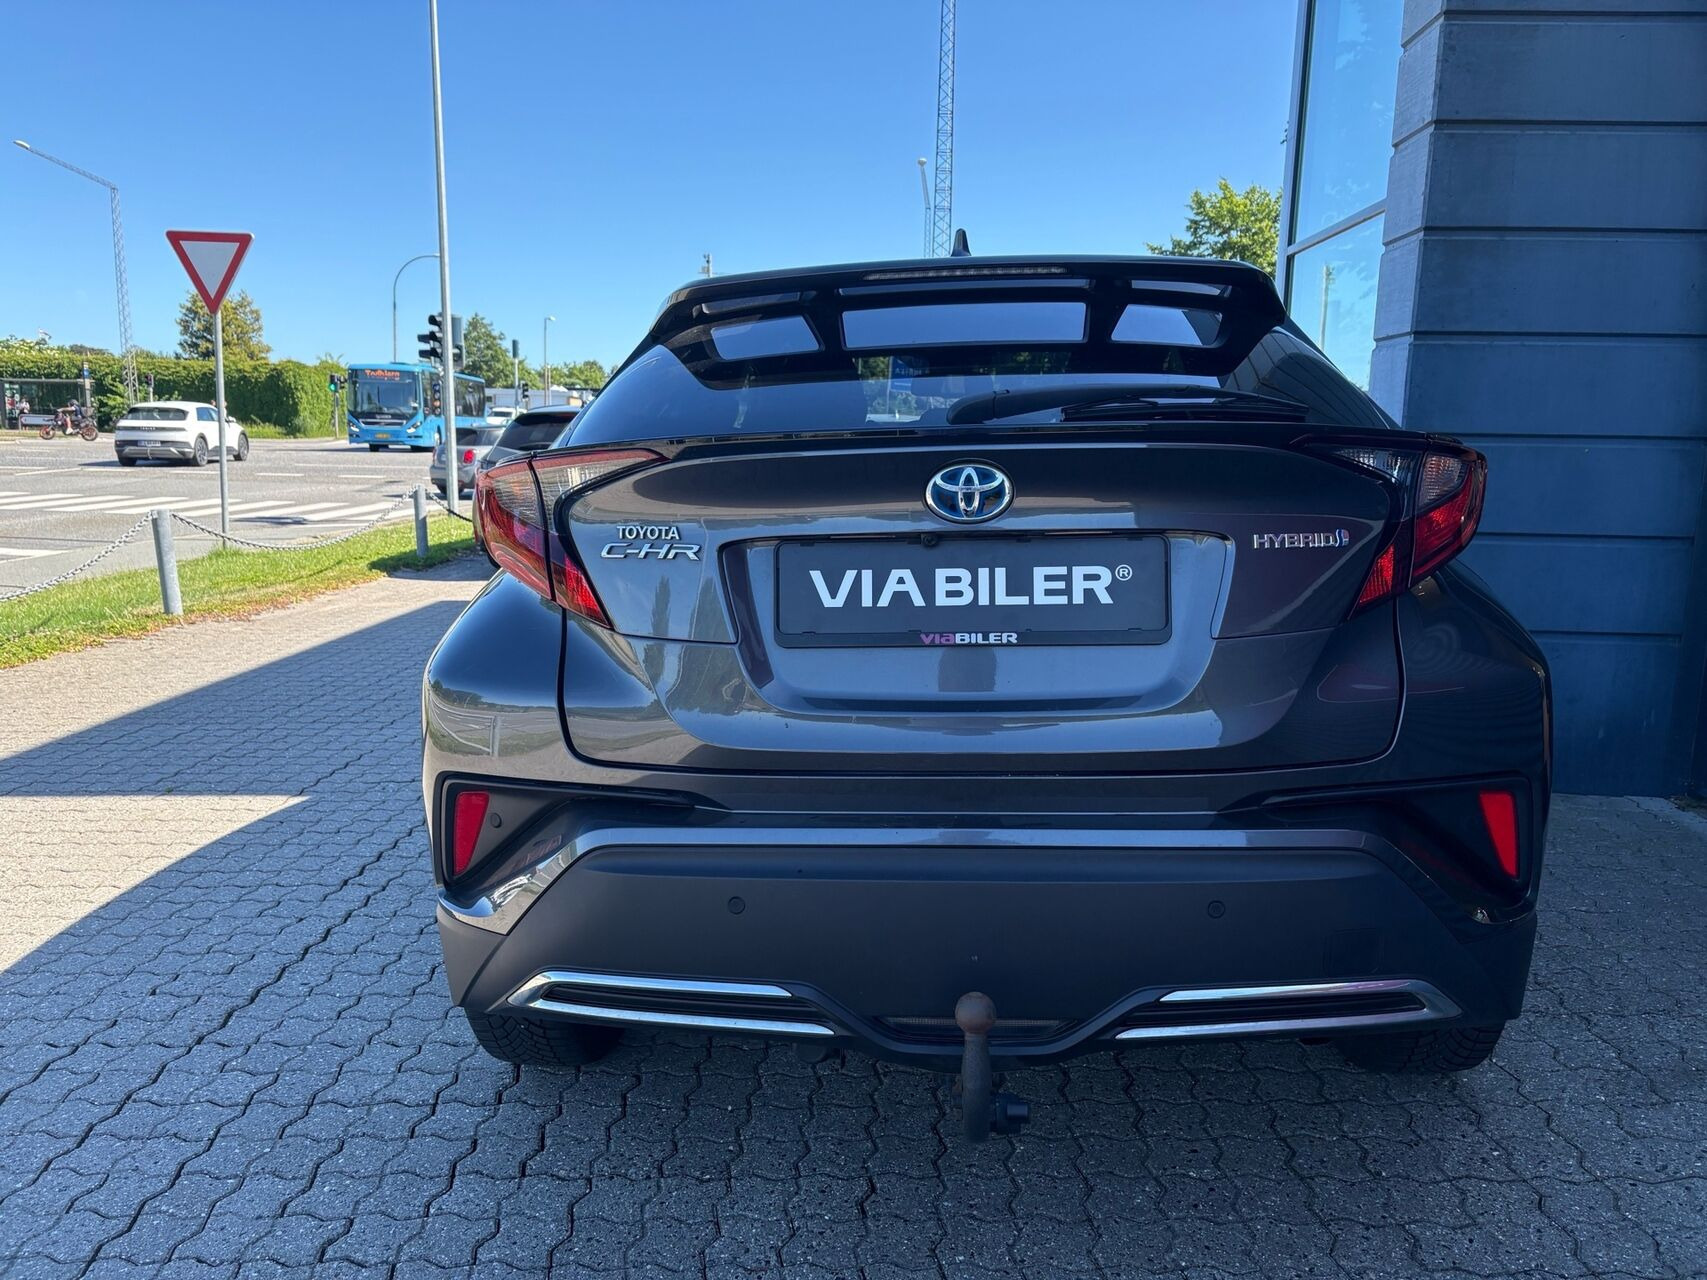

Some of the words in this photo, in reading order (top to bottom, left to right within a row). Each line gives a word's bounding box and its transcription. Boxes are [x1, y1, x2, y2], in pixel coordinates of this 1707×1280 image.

[617, 525, 680, 540] TOYOTA
[1253, 533, 1335, 549] HYBRID
[601, 542, 701, 561] C-HR
[809, 568, 926, 608] VIA
